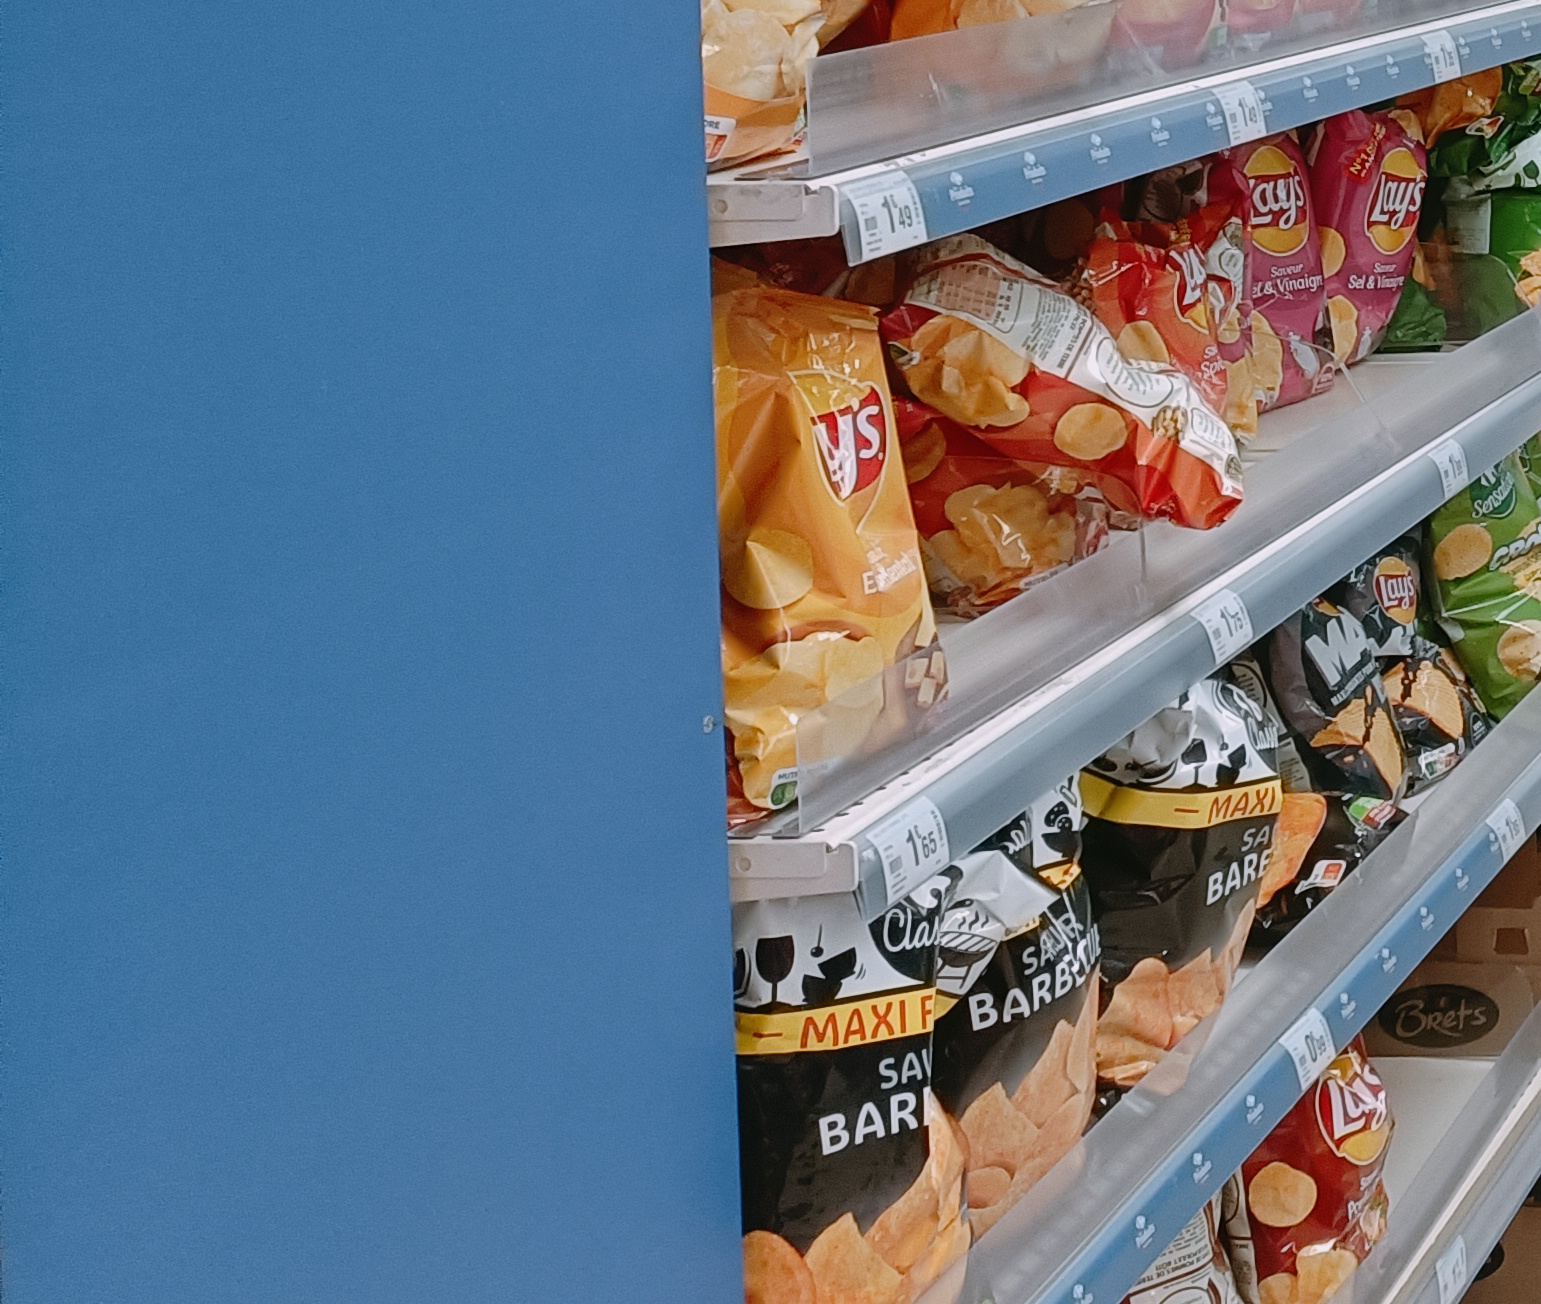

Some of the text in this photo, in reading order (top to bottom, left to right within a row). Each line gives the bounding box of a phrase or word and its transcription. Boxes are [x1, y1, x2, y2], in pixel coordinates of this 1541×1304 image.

[1249, 175, 1305, 230] Lay's
[1373, 173, 1426, 230] Lay's
[1270, 262, 1303, 278] Saveur
[1277, 272, 1323, 294] Vinaigr
[1348, 275, 1364, 290] Sel
[1379, 574, 1416, 610] Lay's
[1208, 788, 1277, 825] MAXI
[883, 907, 940, 951] Clas
[800, 999, 907, 1049] MAXI
